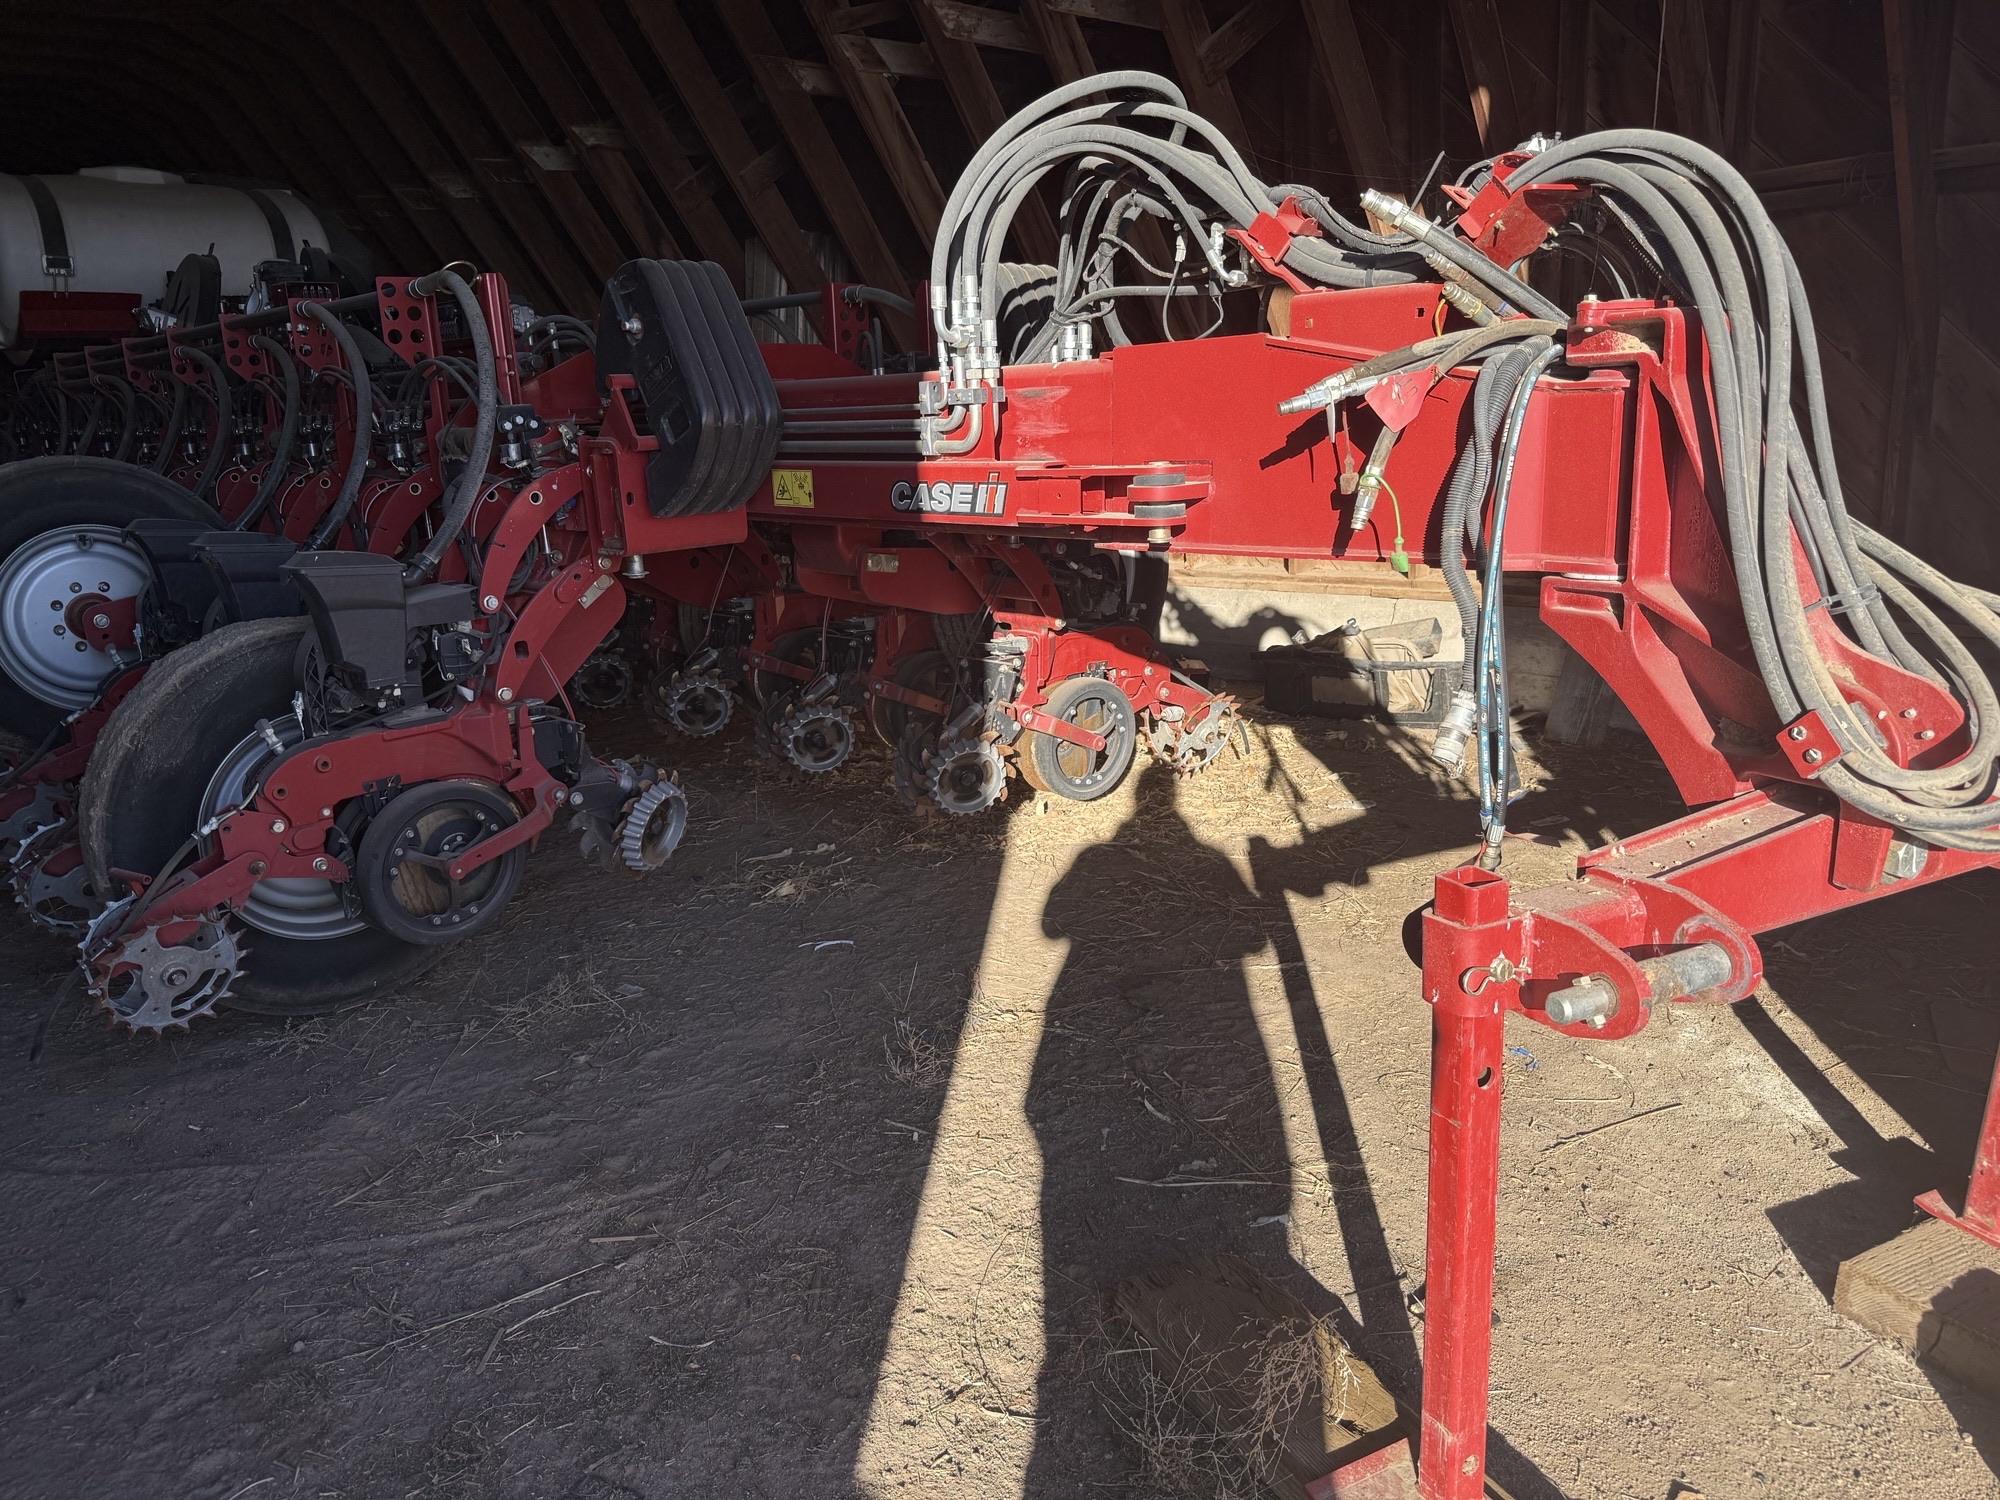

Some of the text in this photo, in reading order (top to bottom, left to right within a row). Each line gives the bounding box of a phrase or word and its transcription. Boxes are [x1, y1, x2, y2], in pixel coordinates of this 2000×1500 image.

[1506, 456, 1515, 481] GATES
[892, 482, 974, 513] CASE
[1496, 779, 1504, 803] GATES
